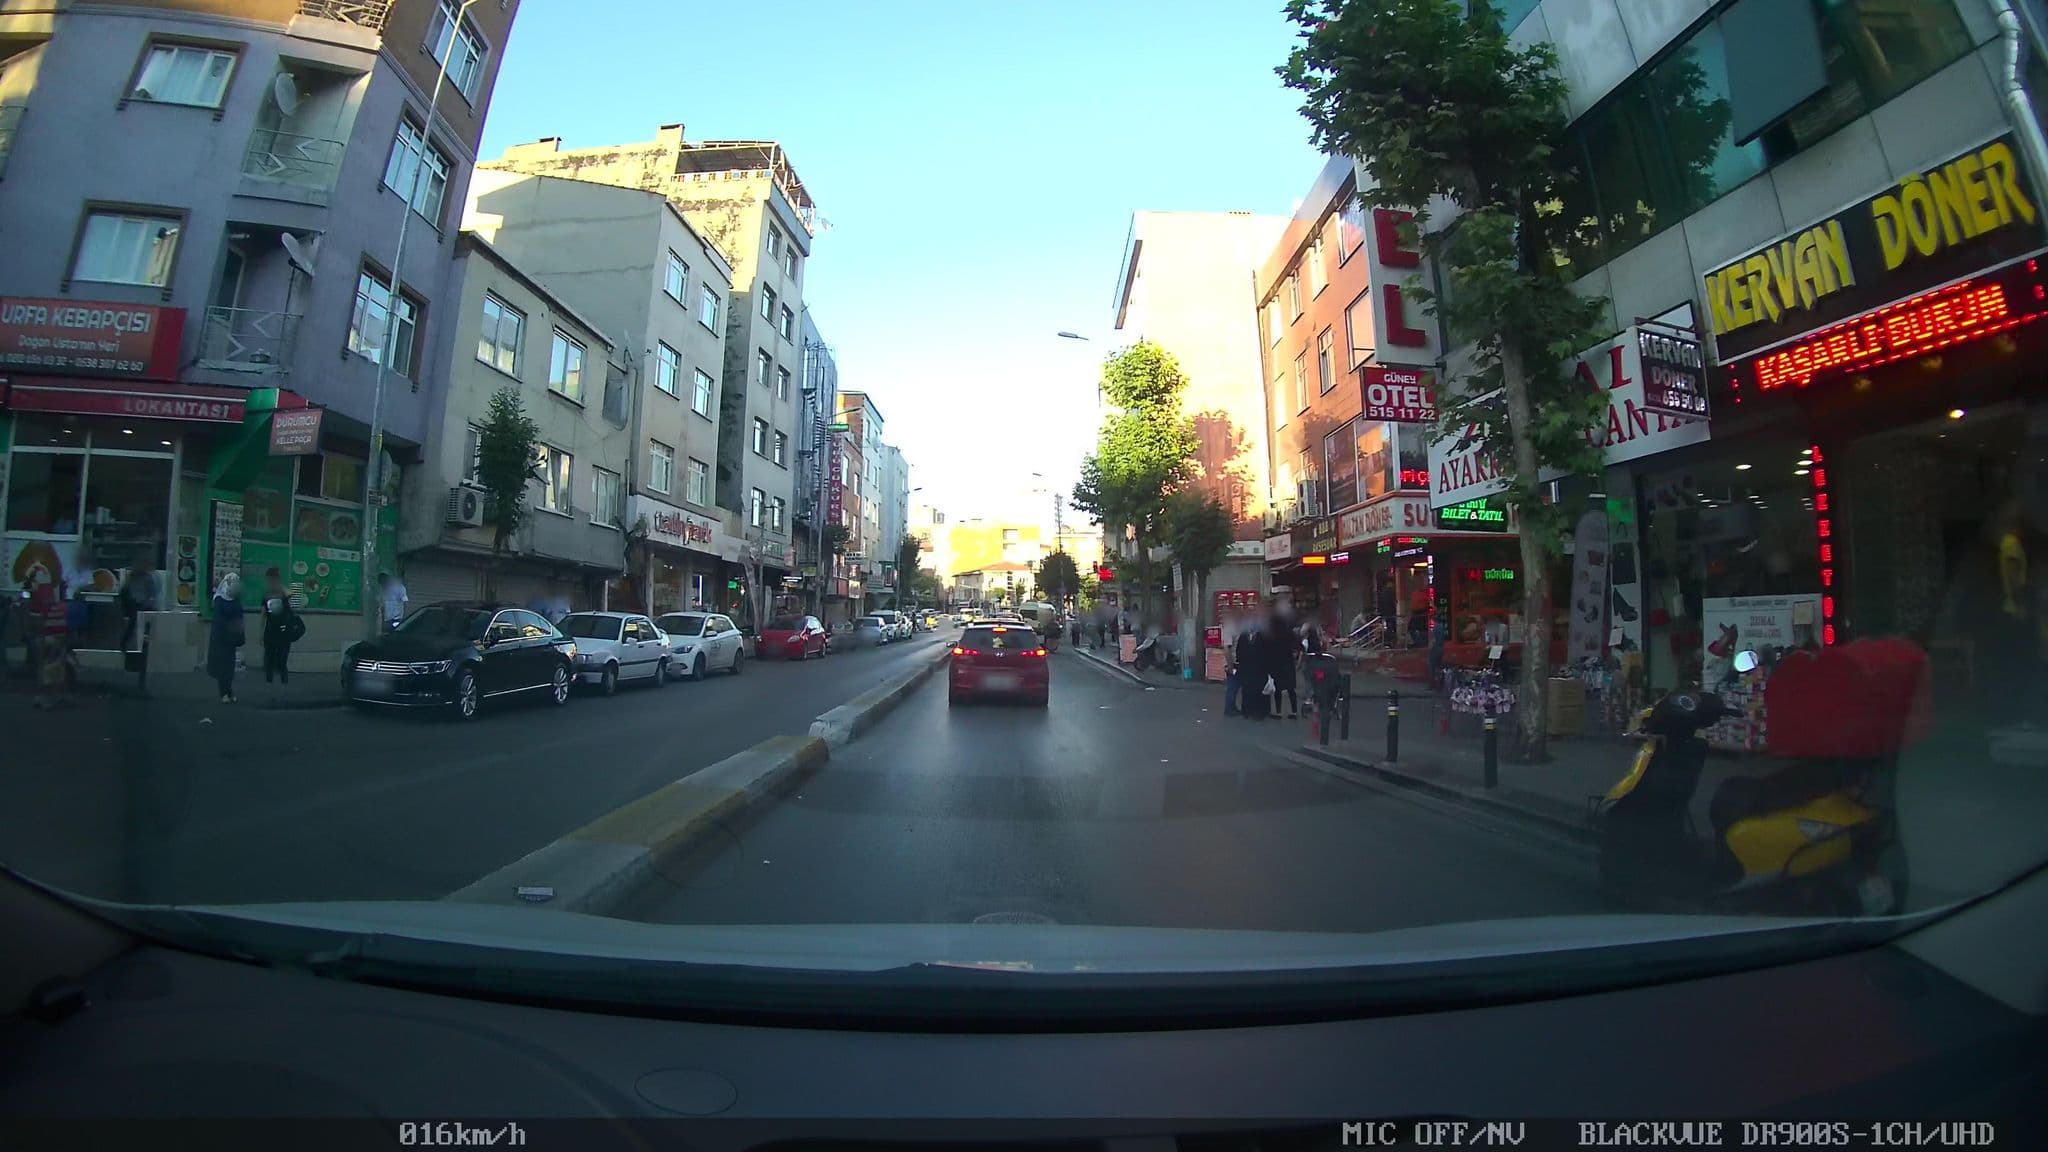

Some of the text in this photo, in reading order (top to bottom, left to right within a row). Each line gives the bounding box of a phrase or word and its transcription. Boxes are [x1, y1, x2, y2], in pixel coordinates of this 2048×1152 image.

[1705, 142, 2035, 335] KERVAN DÖNER
[1, 304, 152, 336] URFA KEBAPÇISI
[1640, 332, 1701, 369] KERVAN
[1384, 372, 1416, 384] GÜNEY
[124, 400, 230, 418] LOKANTASI
[1368, 384, 1435, 409] OTEL
[1369, 406, 1436, 420] 515 11 22
